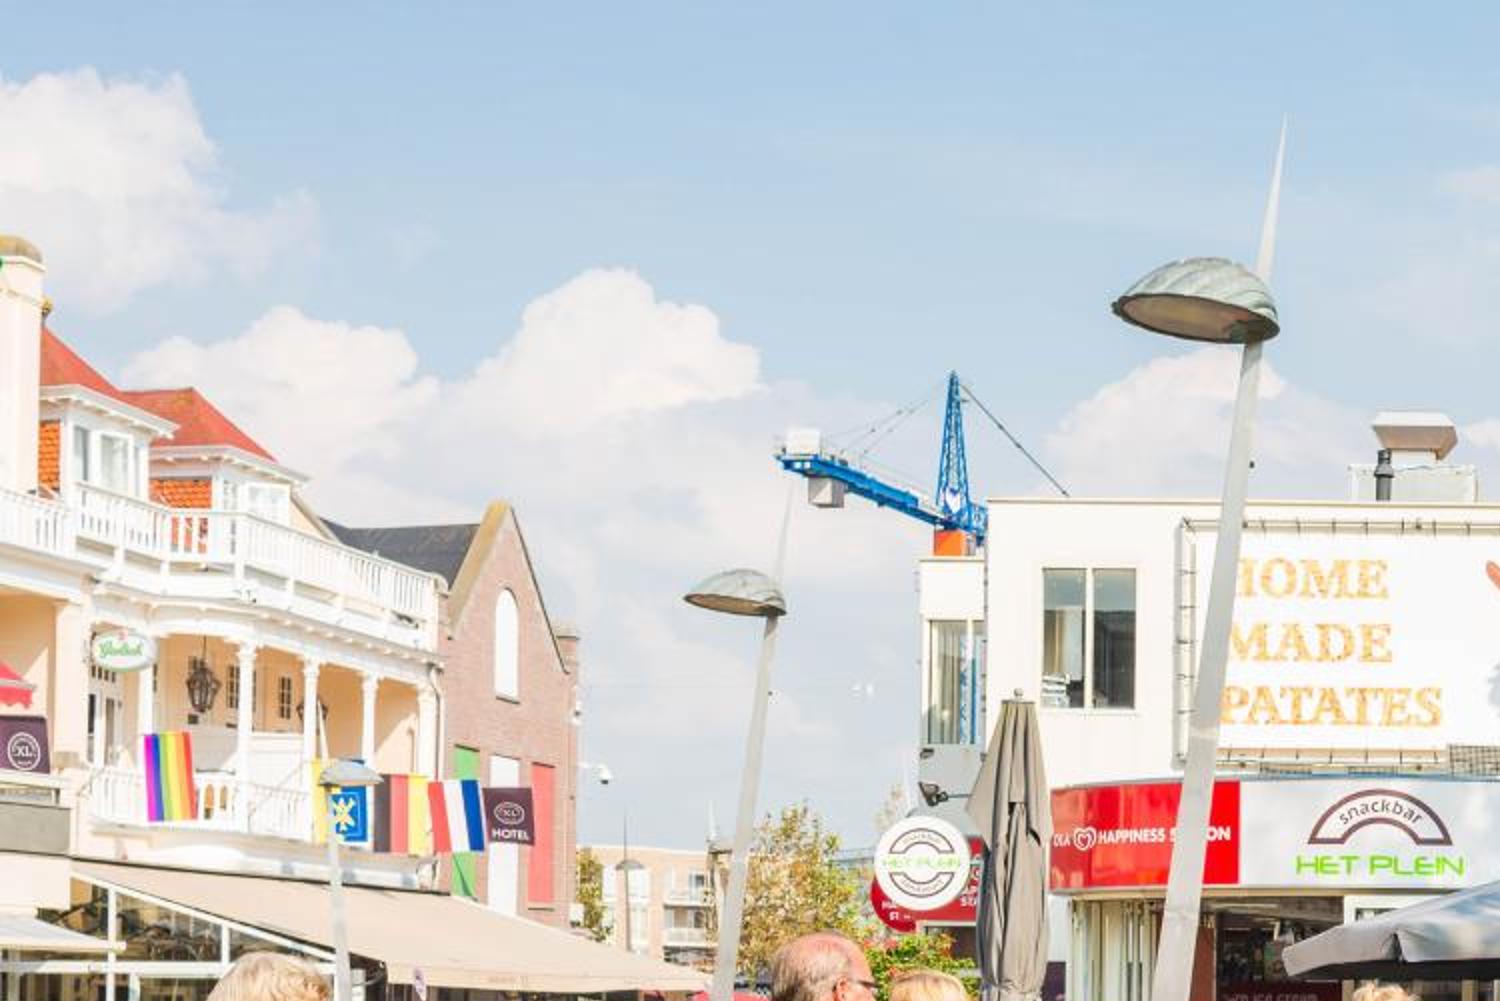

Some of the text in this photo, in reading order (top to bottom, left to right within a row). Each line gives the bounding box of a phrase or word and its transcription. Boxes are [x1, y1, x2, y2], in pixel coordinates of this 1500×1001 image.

[1229, 623, 1393, 662] MADE
[1219, 685, 1443, 726] PATATES
[1339, 799, 1423, 825] snackbar
[492, 828, 530, 841] HOTEL
[1099, 827, 1165, 844] HAPPINESS
[1295, 855, 1465, 877] HET PLEIN
